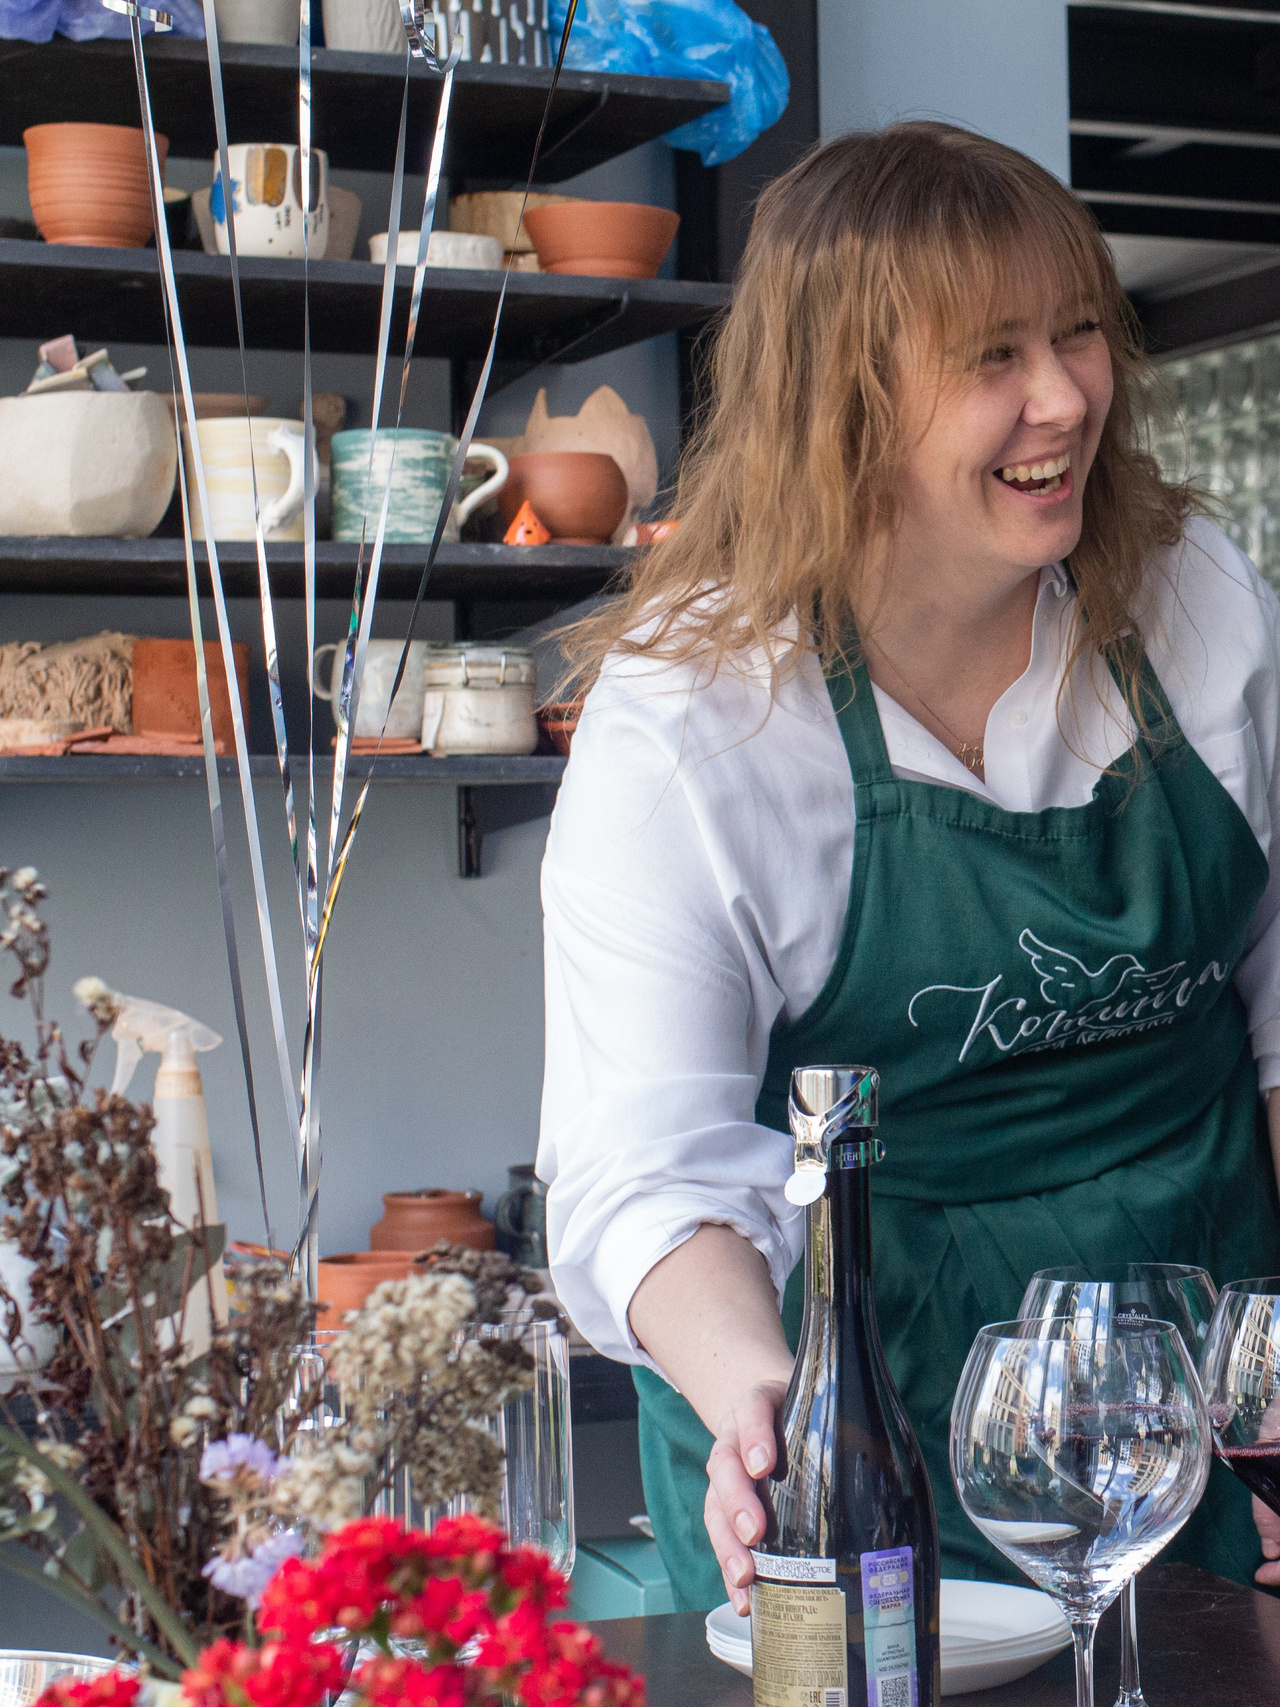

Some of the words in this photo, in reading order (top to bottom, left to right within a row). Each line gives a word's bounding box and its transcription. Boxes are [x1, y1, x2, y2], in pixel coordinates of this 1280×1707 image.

[868, 1556, 908, 1568] РОССИЙСКАЯ
[783, 1570, 817, 1579] СЛАДКОЕ
[868, 1587, 911, 1599] ФЕДЕРАЛЬНАЯ
[868, 1593, 911, 1606] СПЕЦИАЛЬНАЯ
[881, 1602, 902, 1610] МАРКА
